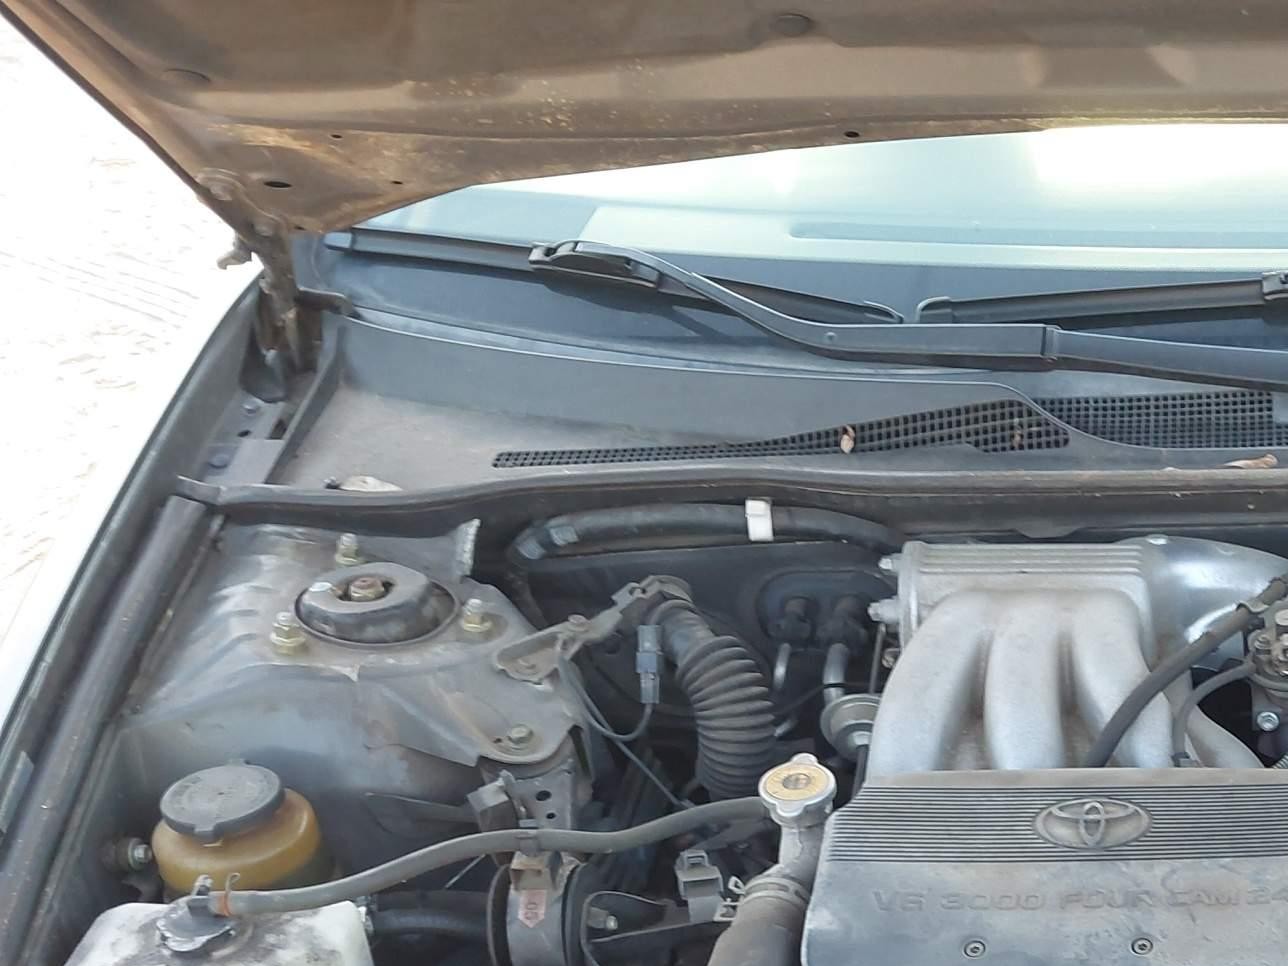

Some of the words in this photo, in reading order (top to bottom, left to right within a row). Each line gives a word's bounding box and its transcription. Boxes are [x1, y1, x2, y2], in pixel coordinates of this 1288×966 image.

[941, 892, 1045, 912] 3000
[1058, 889, 1155, 911] FOUR
[1166, 889, 1241, 908] CAM
